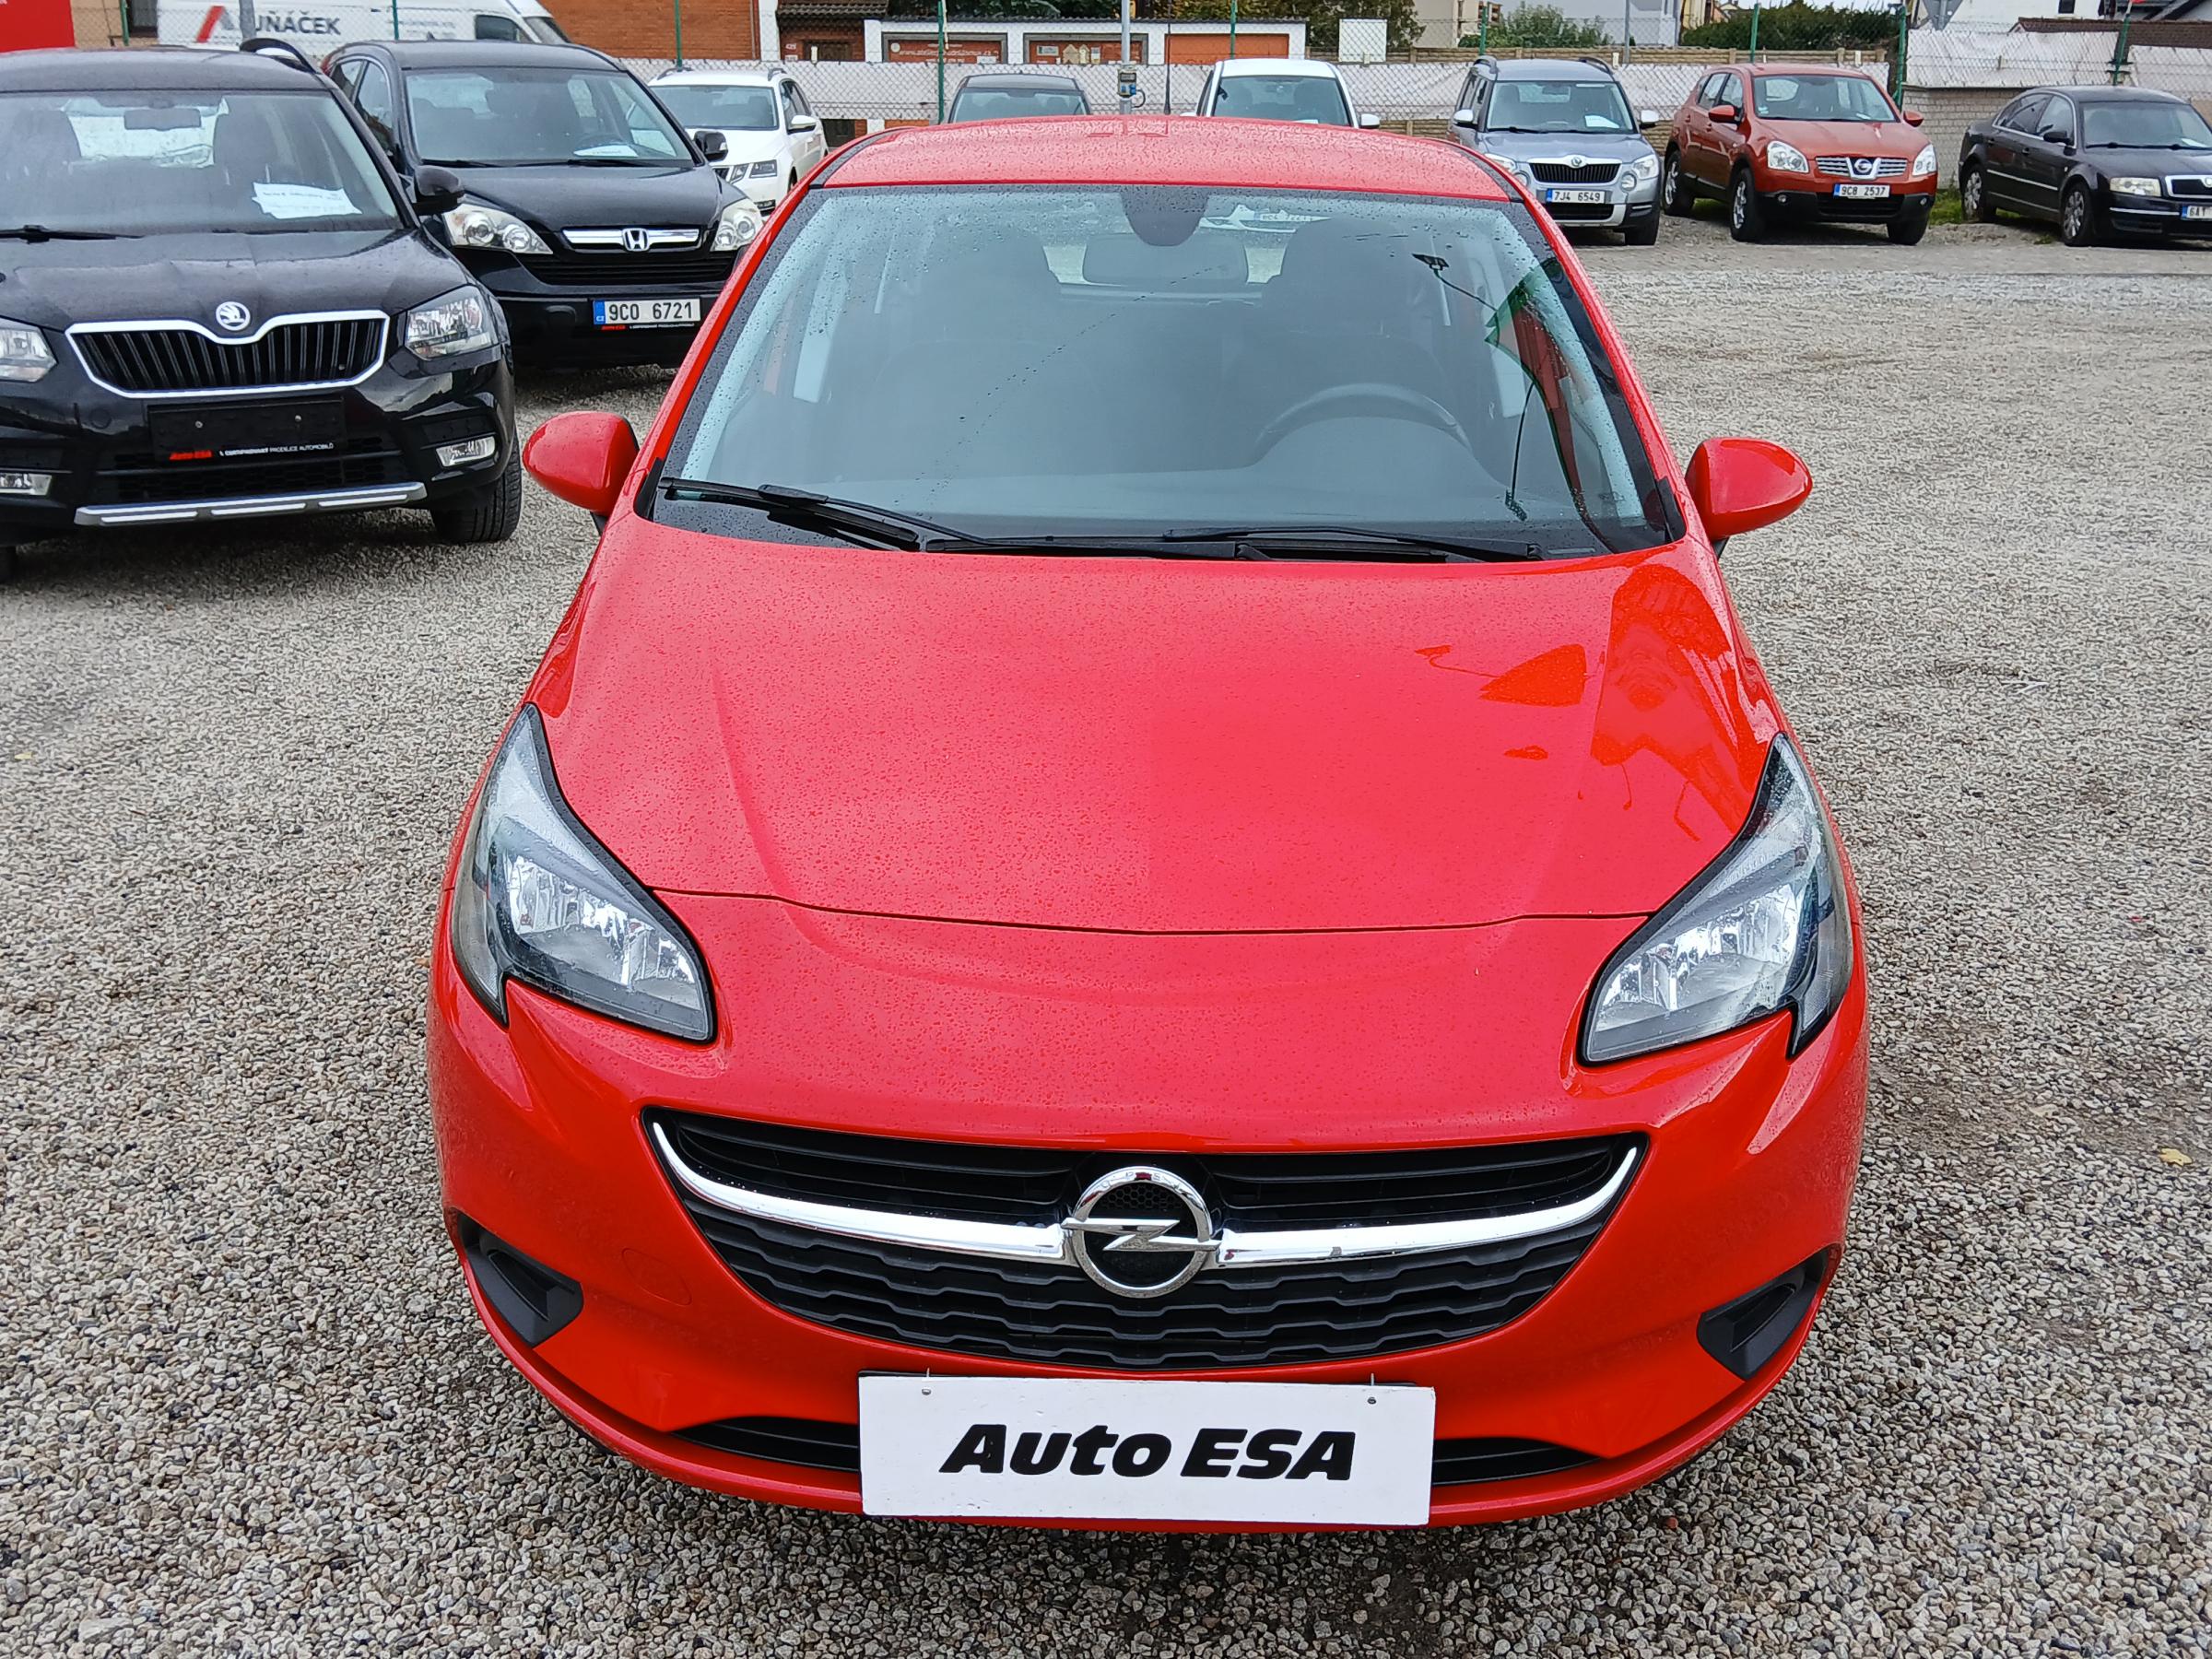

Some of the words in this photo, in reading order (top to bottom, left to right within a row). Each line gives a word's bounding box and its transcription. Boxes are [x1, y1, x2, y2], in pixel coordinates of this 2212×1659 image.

[1555, 191, 1571, 201] 7J4
[1577, 192, 1601, 202] 6549
[1841, 186, 1858, 195] 9C8
[1864, 186, 1886, 196] 2537
[609, 303, 640, 321] 9C0
[653, 302, 691, 319] 6721
[938, 1424, 1172, 1477] Auto
[1180, 1427, 1357, 1481] ESA
